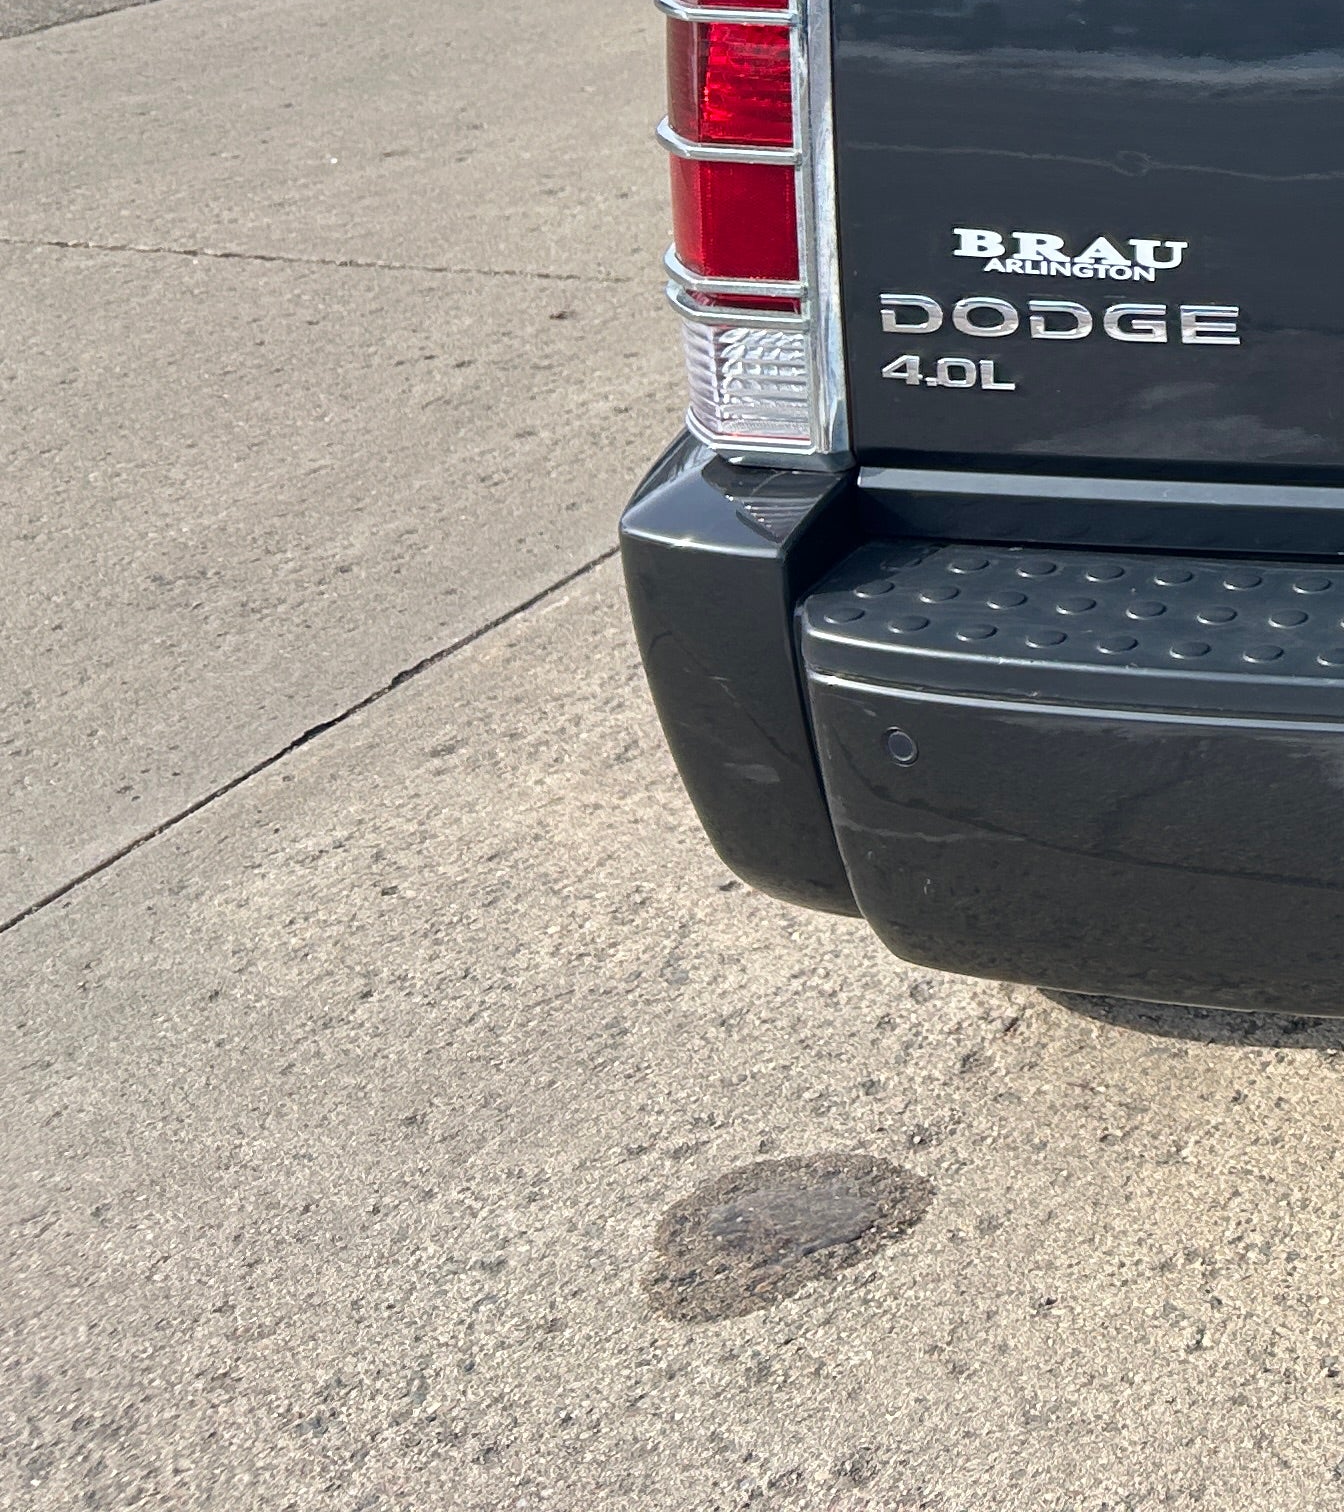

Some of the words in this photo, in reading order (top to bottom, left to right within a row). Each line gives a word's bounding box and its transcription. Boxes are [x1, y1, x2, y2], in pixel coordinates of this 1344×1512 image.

[953, 228, 1188, 269] BRAU
[984, 257, 1156, 282] ARLINGTON
[880, 294, 1241, 345] DODGE
[881, 354, 1016, 391] 4.0L
